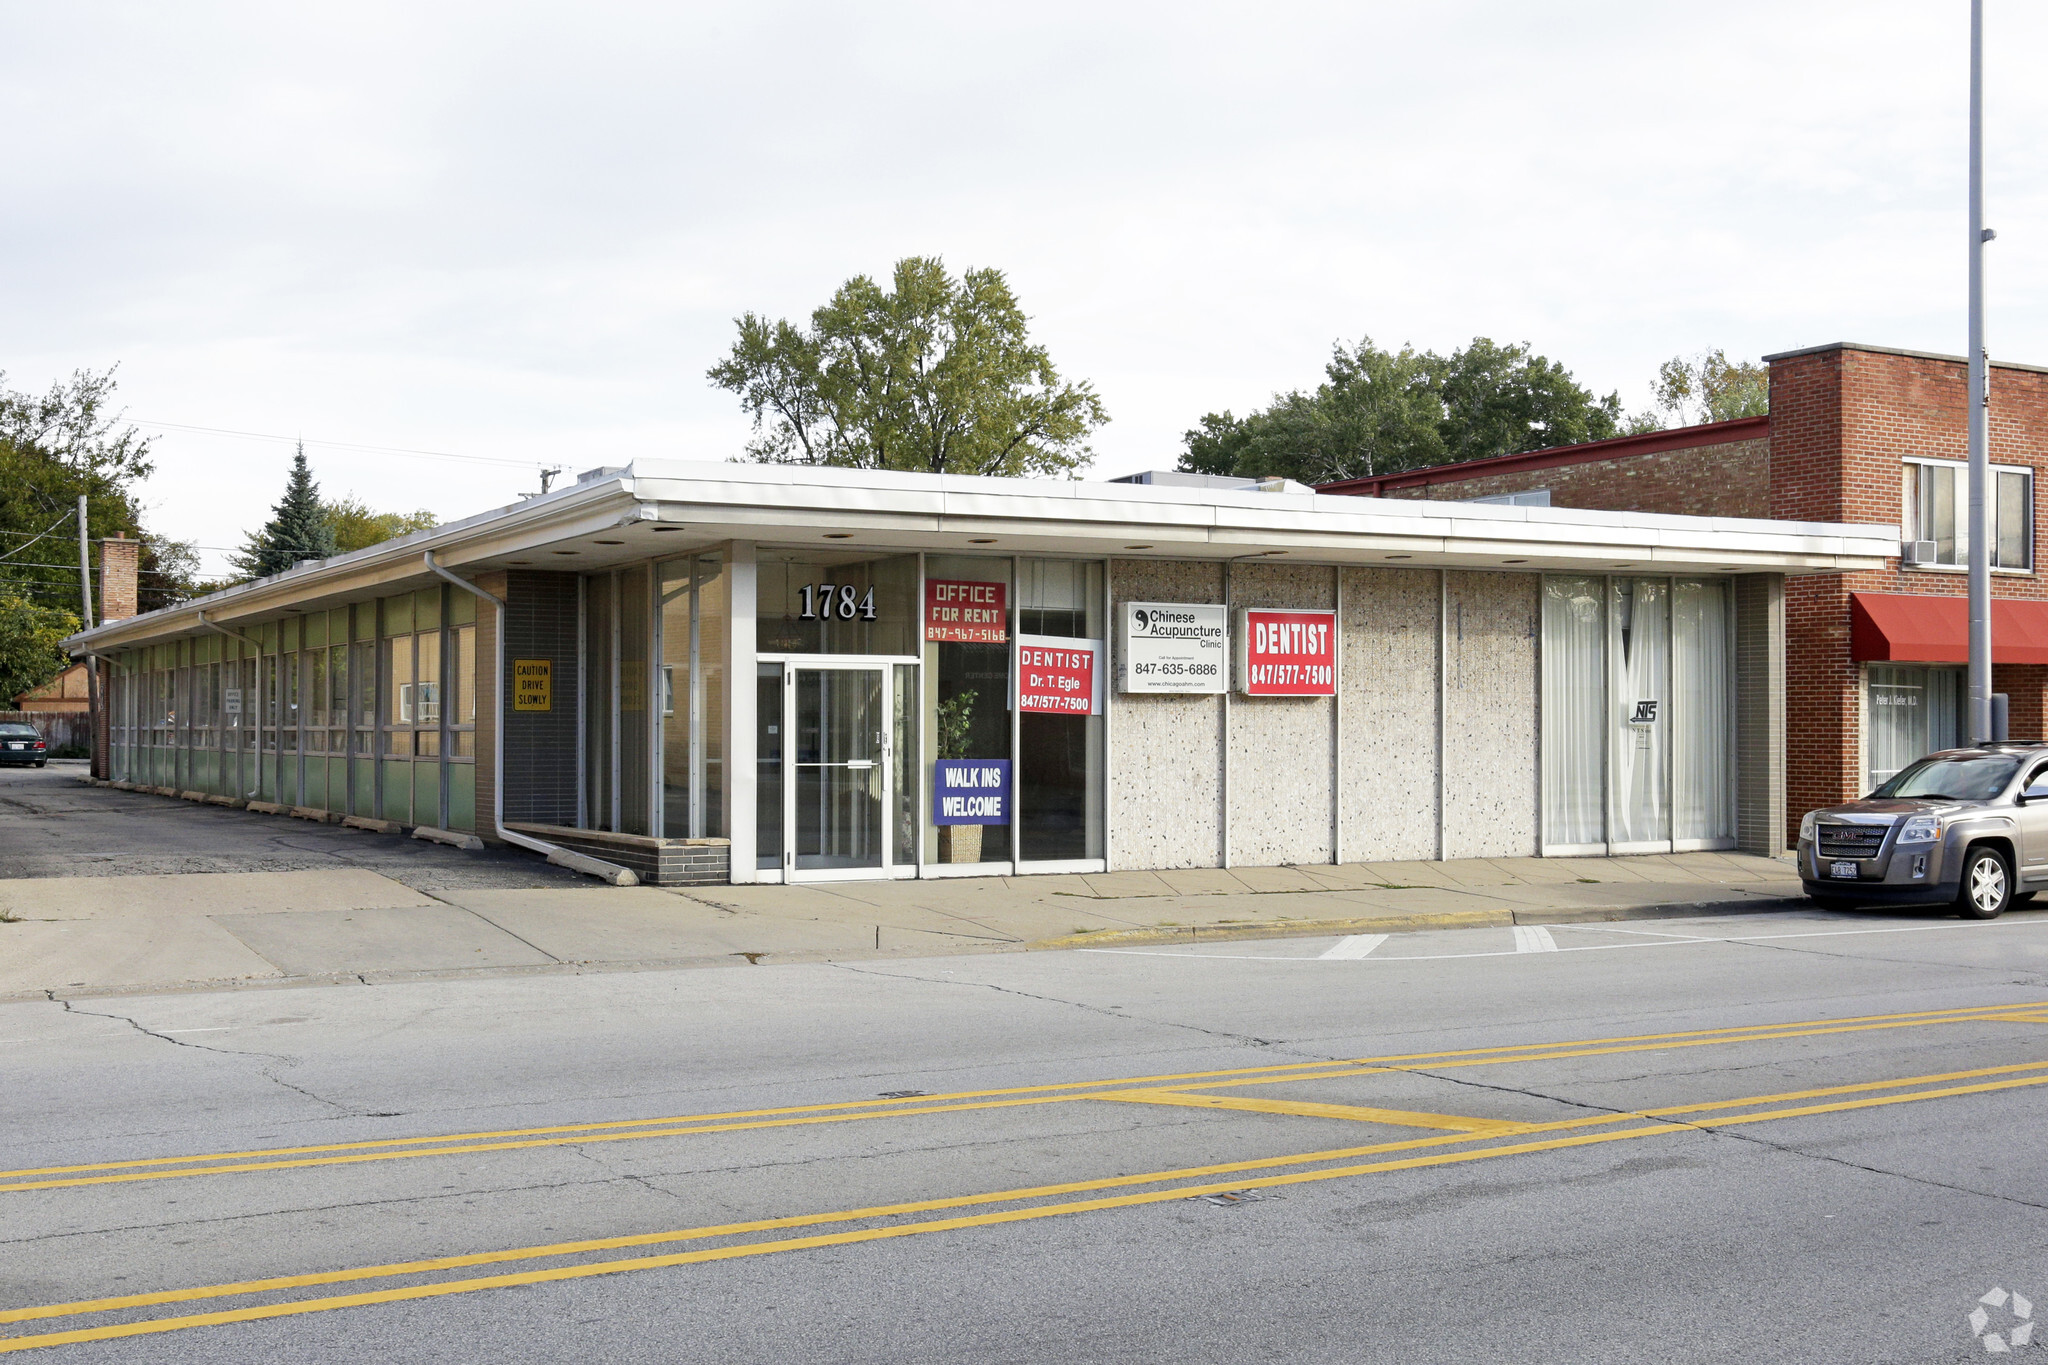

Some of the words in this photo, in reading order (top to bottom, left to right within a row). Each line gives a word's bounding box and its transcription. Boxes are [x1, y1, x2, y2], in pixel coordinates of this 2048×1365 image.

[936, 584, 996, 603] OFFICE
[798, 583, 877, 621] 1784
[932, 606, 959, 622] FOR
[964, 608, 999, 624] RENT
[1150, 610, 1196, 624] Chinese
[928, 627, 1005, 641] 847-967-5168
[1150, 623, 1222, 639] Acupuncture
[1255, 622, 1328, 655] DENTIST
[1200, 639, 1222, 649] Clinic
[1021, 650, 1091, 670] DENTIST
[517, 665, 549, 676] CAUTION
[1135, 662, 1218, 676] 847-635-6886
[1251, 664, 1332, 685] 847/577-7500
[522, 680, 544, 690] DRIVE
[1030, 673, 1044, 688] Dr.
[1047, 675, 1056, 688] T.
[1058, 676, 1080, 692] Egle
[518, 694, 547, 705] SLOWLY
[1020, 694, 1089, 711] 847/577-7500
[1876, 694, 1888, 705] Peter
[945, 767, 979, 788] WALK
[981, 767, 1001, 788] INS
[942, 796, 1002, 817] WELCOME
[1832, 831, 1864, 840] GMC
